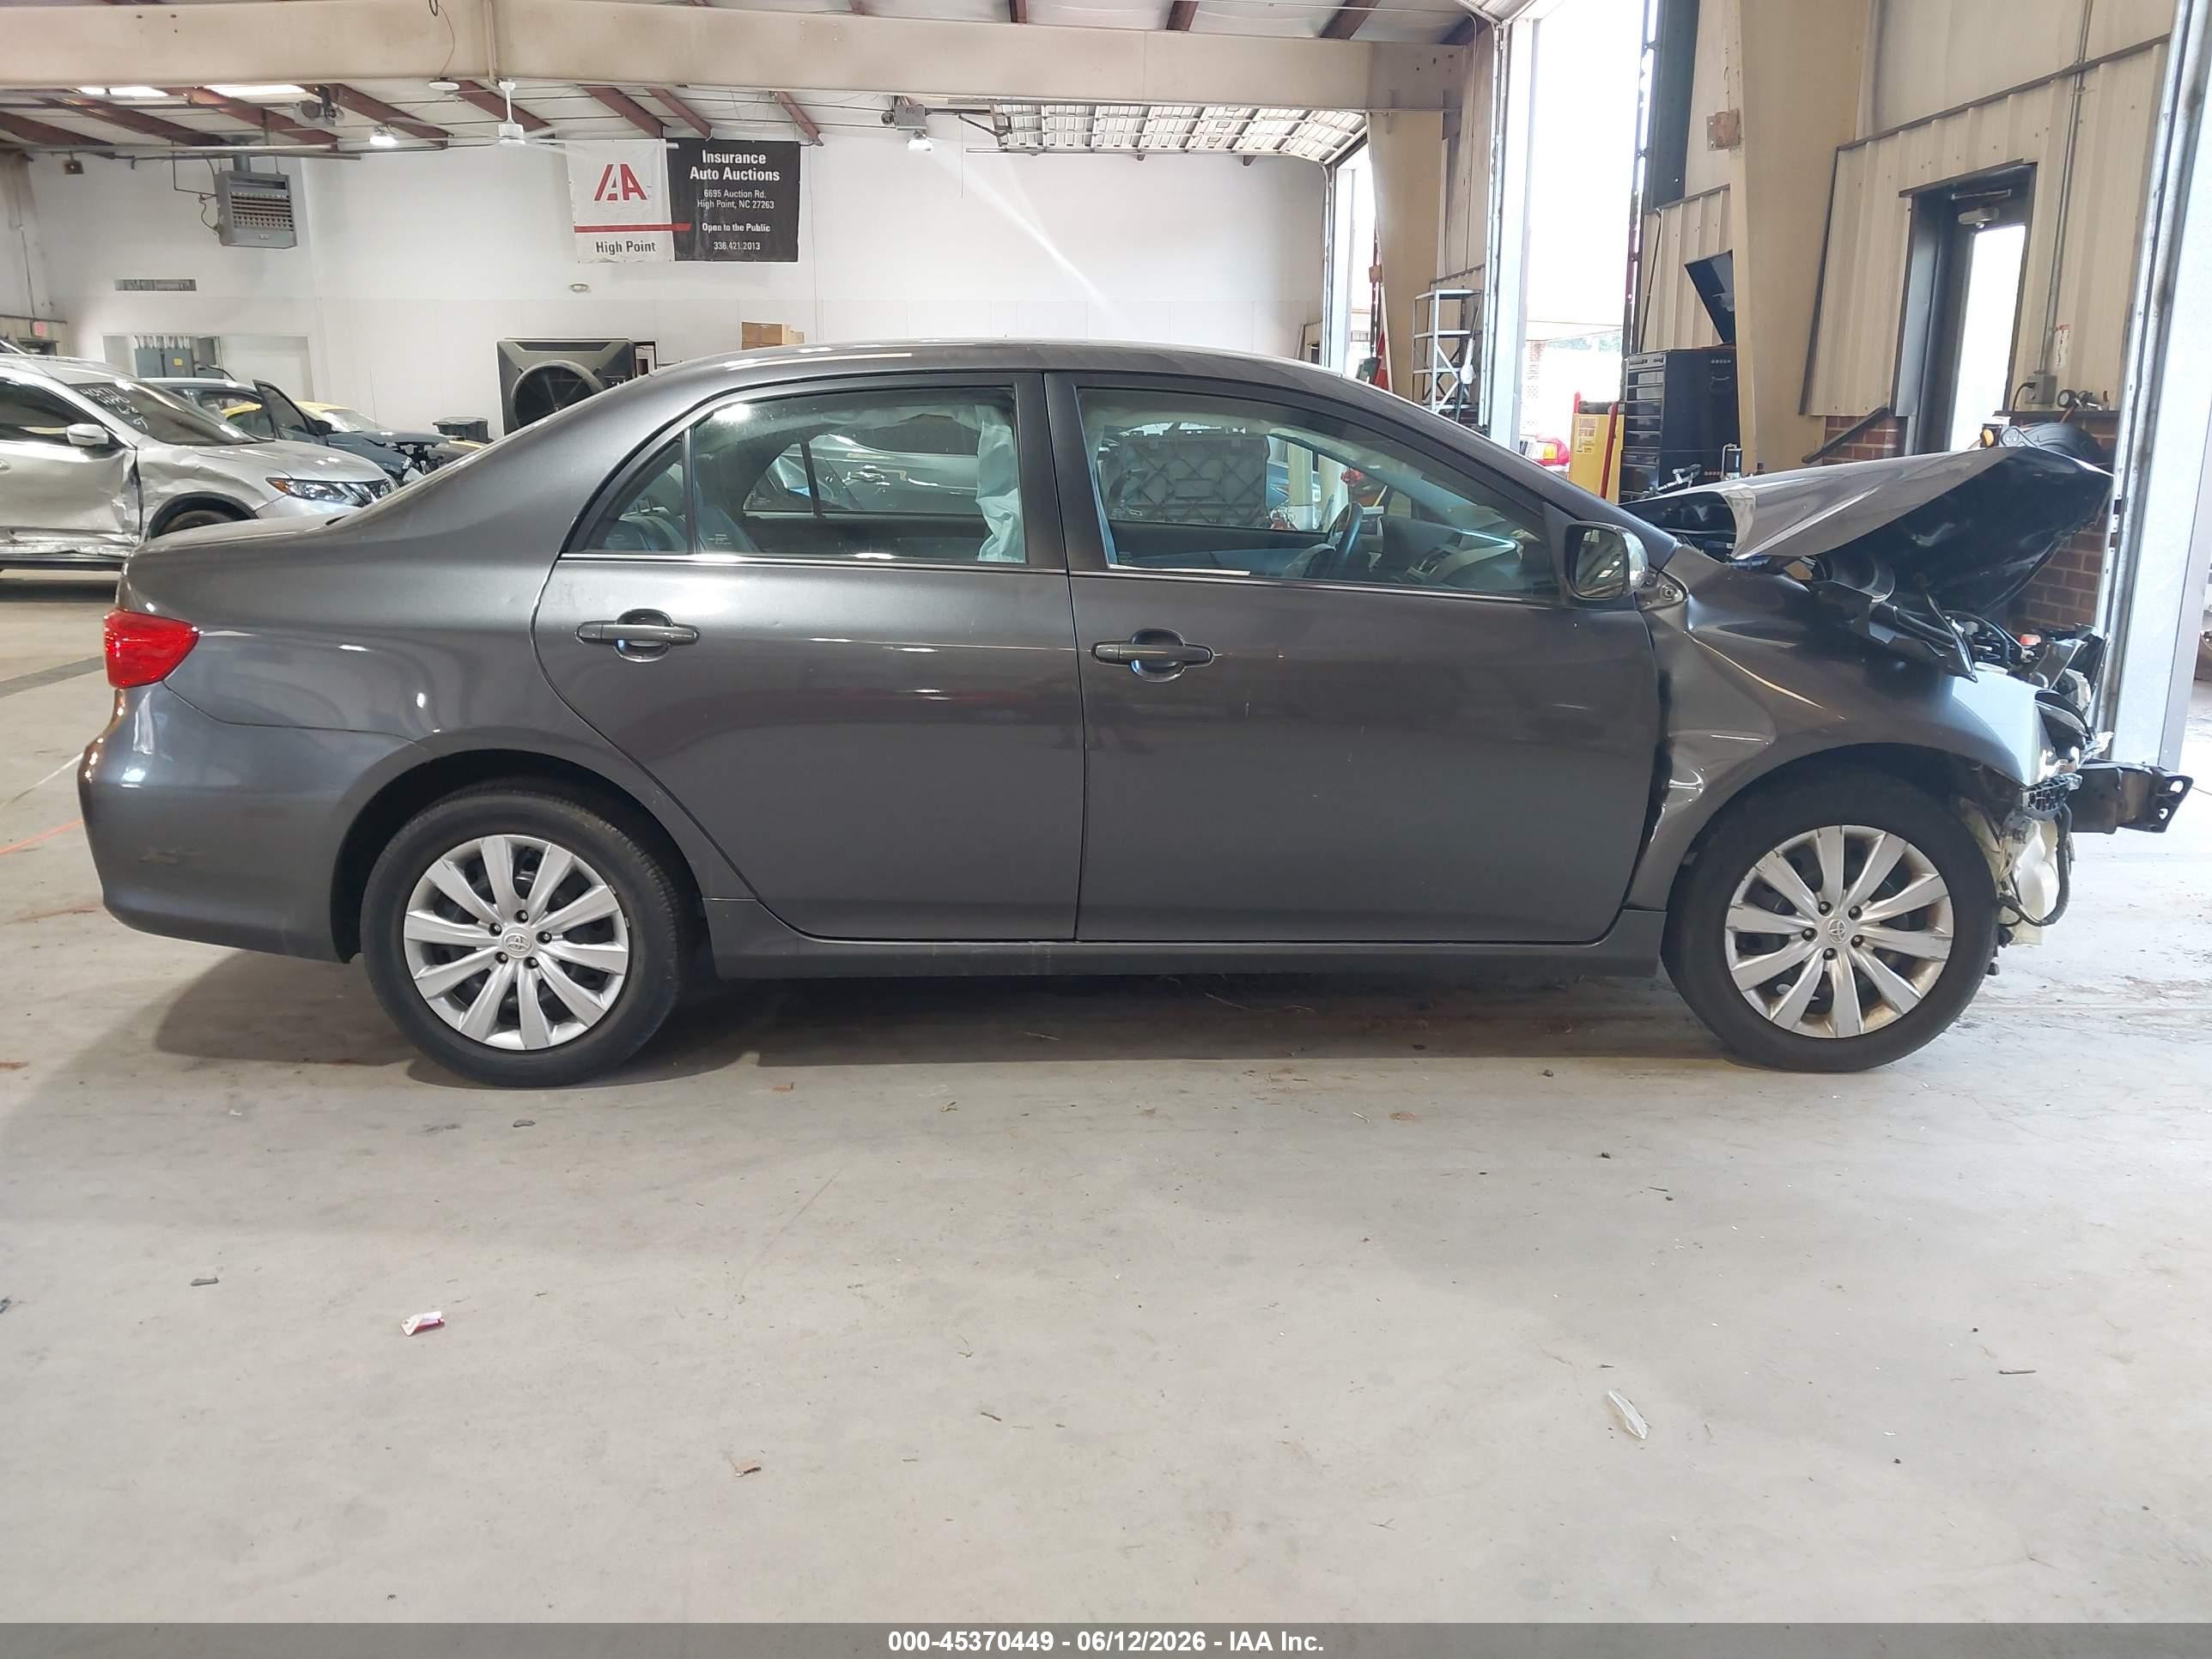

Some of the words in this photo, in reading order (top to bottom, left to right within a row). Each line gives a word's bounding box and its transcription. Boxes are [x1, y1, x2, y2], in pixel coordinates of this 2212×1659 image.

[702, 149, 767, 164] Insurance
[690, 166, 720, 180] Auto
[722, 167, 781, 181] Auctions
[704, 189, 721, 198] 6695
[723, 189, 753, 198] Auction
[754, 189, 767, 198] Rd.
[697, 199, 714, 210] High
[716, 199, 737, 209] Point,
[738, 199, 750, 209] NC
[752, 200, 775, 209] 27263
[702, 222, 722, 234] Open
[723, 223, 731, 232] to
[732, 223, 744, 232] the
[745, 223, 771, 232] Public
[595, 240, 623, 256] High
[625, 240, 656, 252] Point
